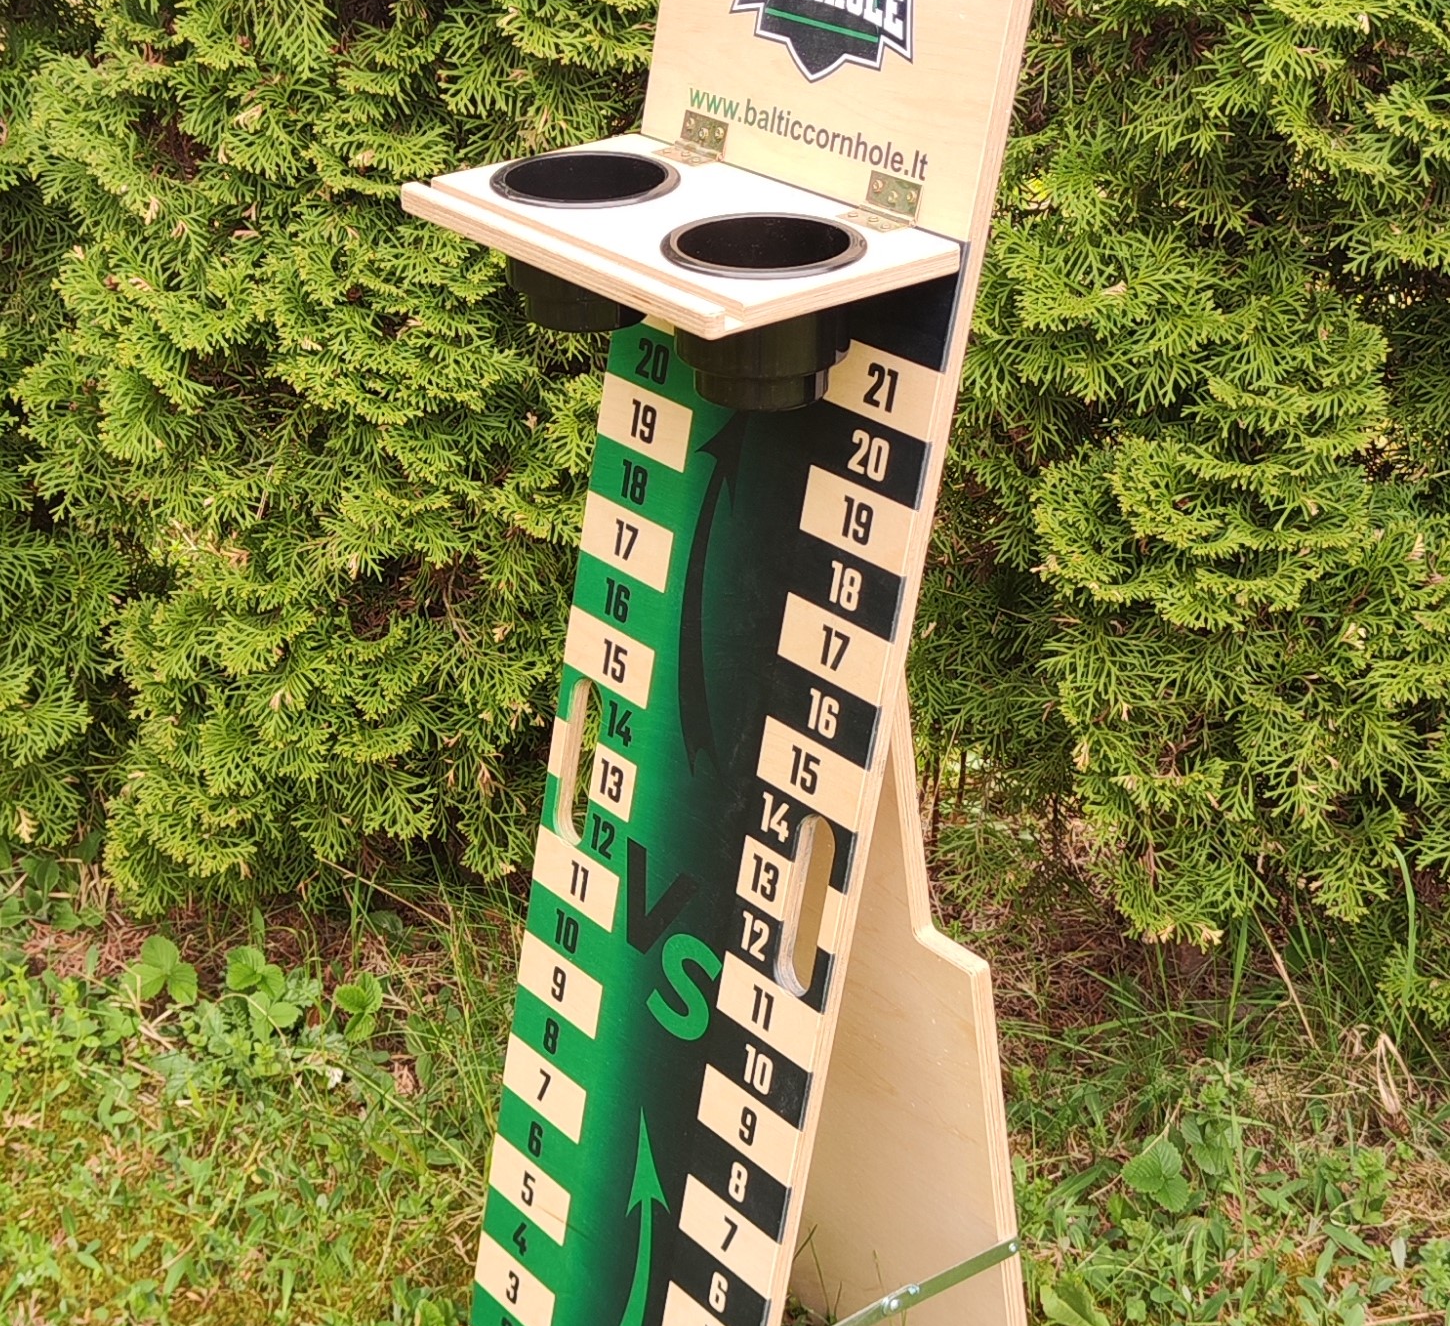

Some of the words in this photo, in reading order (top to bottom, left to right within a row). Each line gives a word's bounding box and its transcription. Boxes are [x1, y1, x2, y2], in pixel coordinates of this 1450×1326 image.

[689, 88, 928, 180] www.balticcornhole.lt
[635, 338, 669, 384] 20
[863, 362, 898, 413] 21
[630, 399, 657, 444] 19
[847, 429, 890, 482] 20
[622, 459, 648, 505] 18
[615, 519, 639, 560] 17
[841, 495, 874, 546] 19
[604, 578, 630, 623] 16
[828, 560, 862, 611] 18
[602, 638, 627, 684] 15
[821, 625, 850, 671] 17
[608, 700, 632, 747] 14
[807, 687, 840, 739] 16
[599, 758, 623, 803] 13
[789, 745, 821, 795] 15
[591, 813, 615, 860] 12
[760, 791, 789, 842] 14
[570, 860, 589, 902] 11
[752, 853, 778, 902] 13
[555, 908, 579, 954] 10
[741, 911, 770, 962] 12
[551, 966, 566, 1002] 9
[751, 984, 774, 1031] 11
[543, 1018, 559, 1055] 8
[536, 1069, 551, 1101] 7
[743, 1044, 773, 1095] 10
[528, 1121, 543, 1158] 6
[738, 1107, 758, 1146] 9
[521, 1170, 534, 1207] 5
[728, 1162, 748, 1203] 8
[512, 1222, 527, 1257] 4
[721, 1215, 738, 1252] 7
[506, 1270, 520, 1305] 3
[708, 1272, 728, 1313] 6
